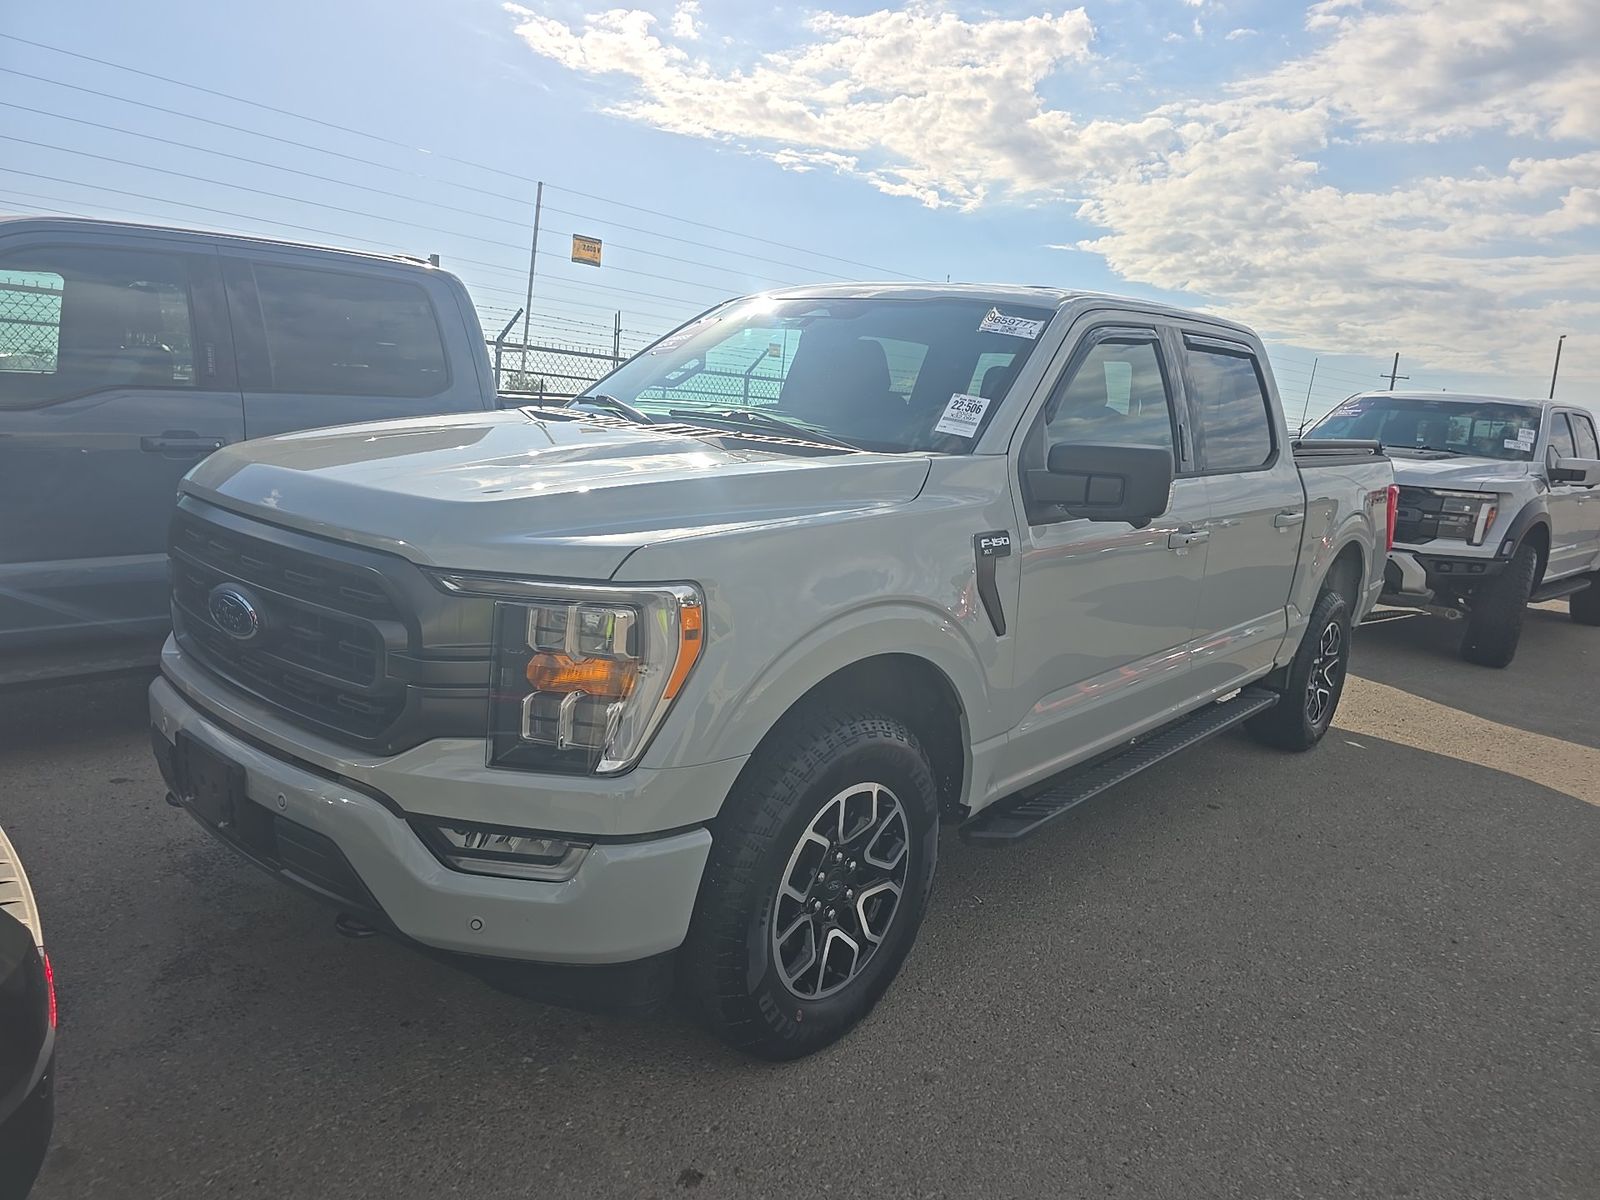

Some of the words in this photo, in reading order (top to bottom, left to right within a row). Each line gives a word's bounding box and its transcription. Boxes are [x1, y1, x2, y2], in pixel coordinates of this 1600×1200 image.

[987, 310, 1037, 329] 9659777
[950, 400, 983, 415] 22:506
[980, 536, 1010, 548] F-150
